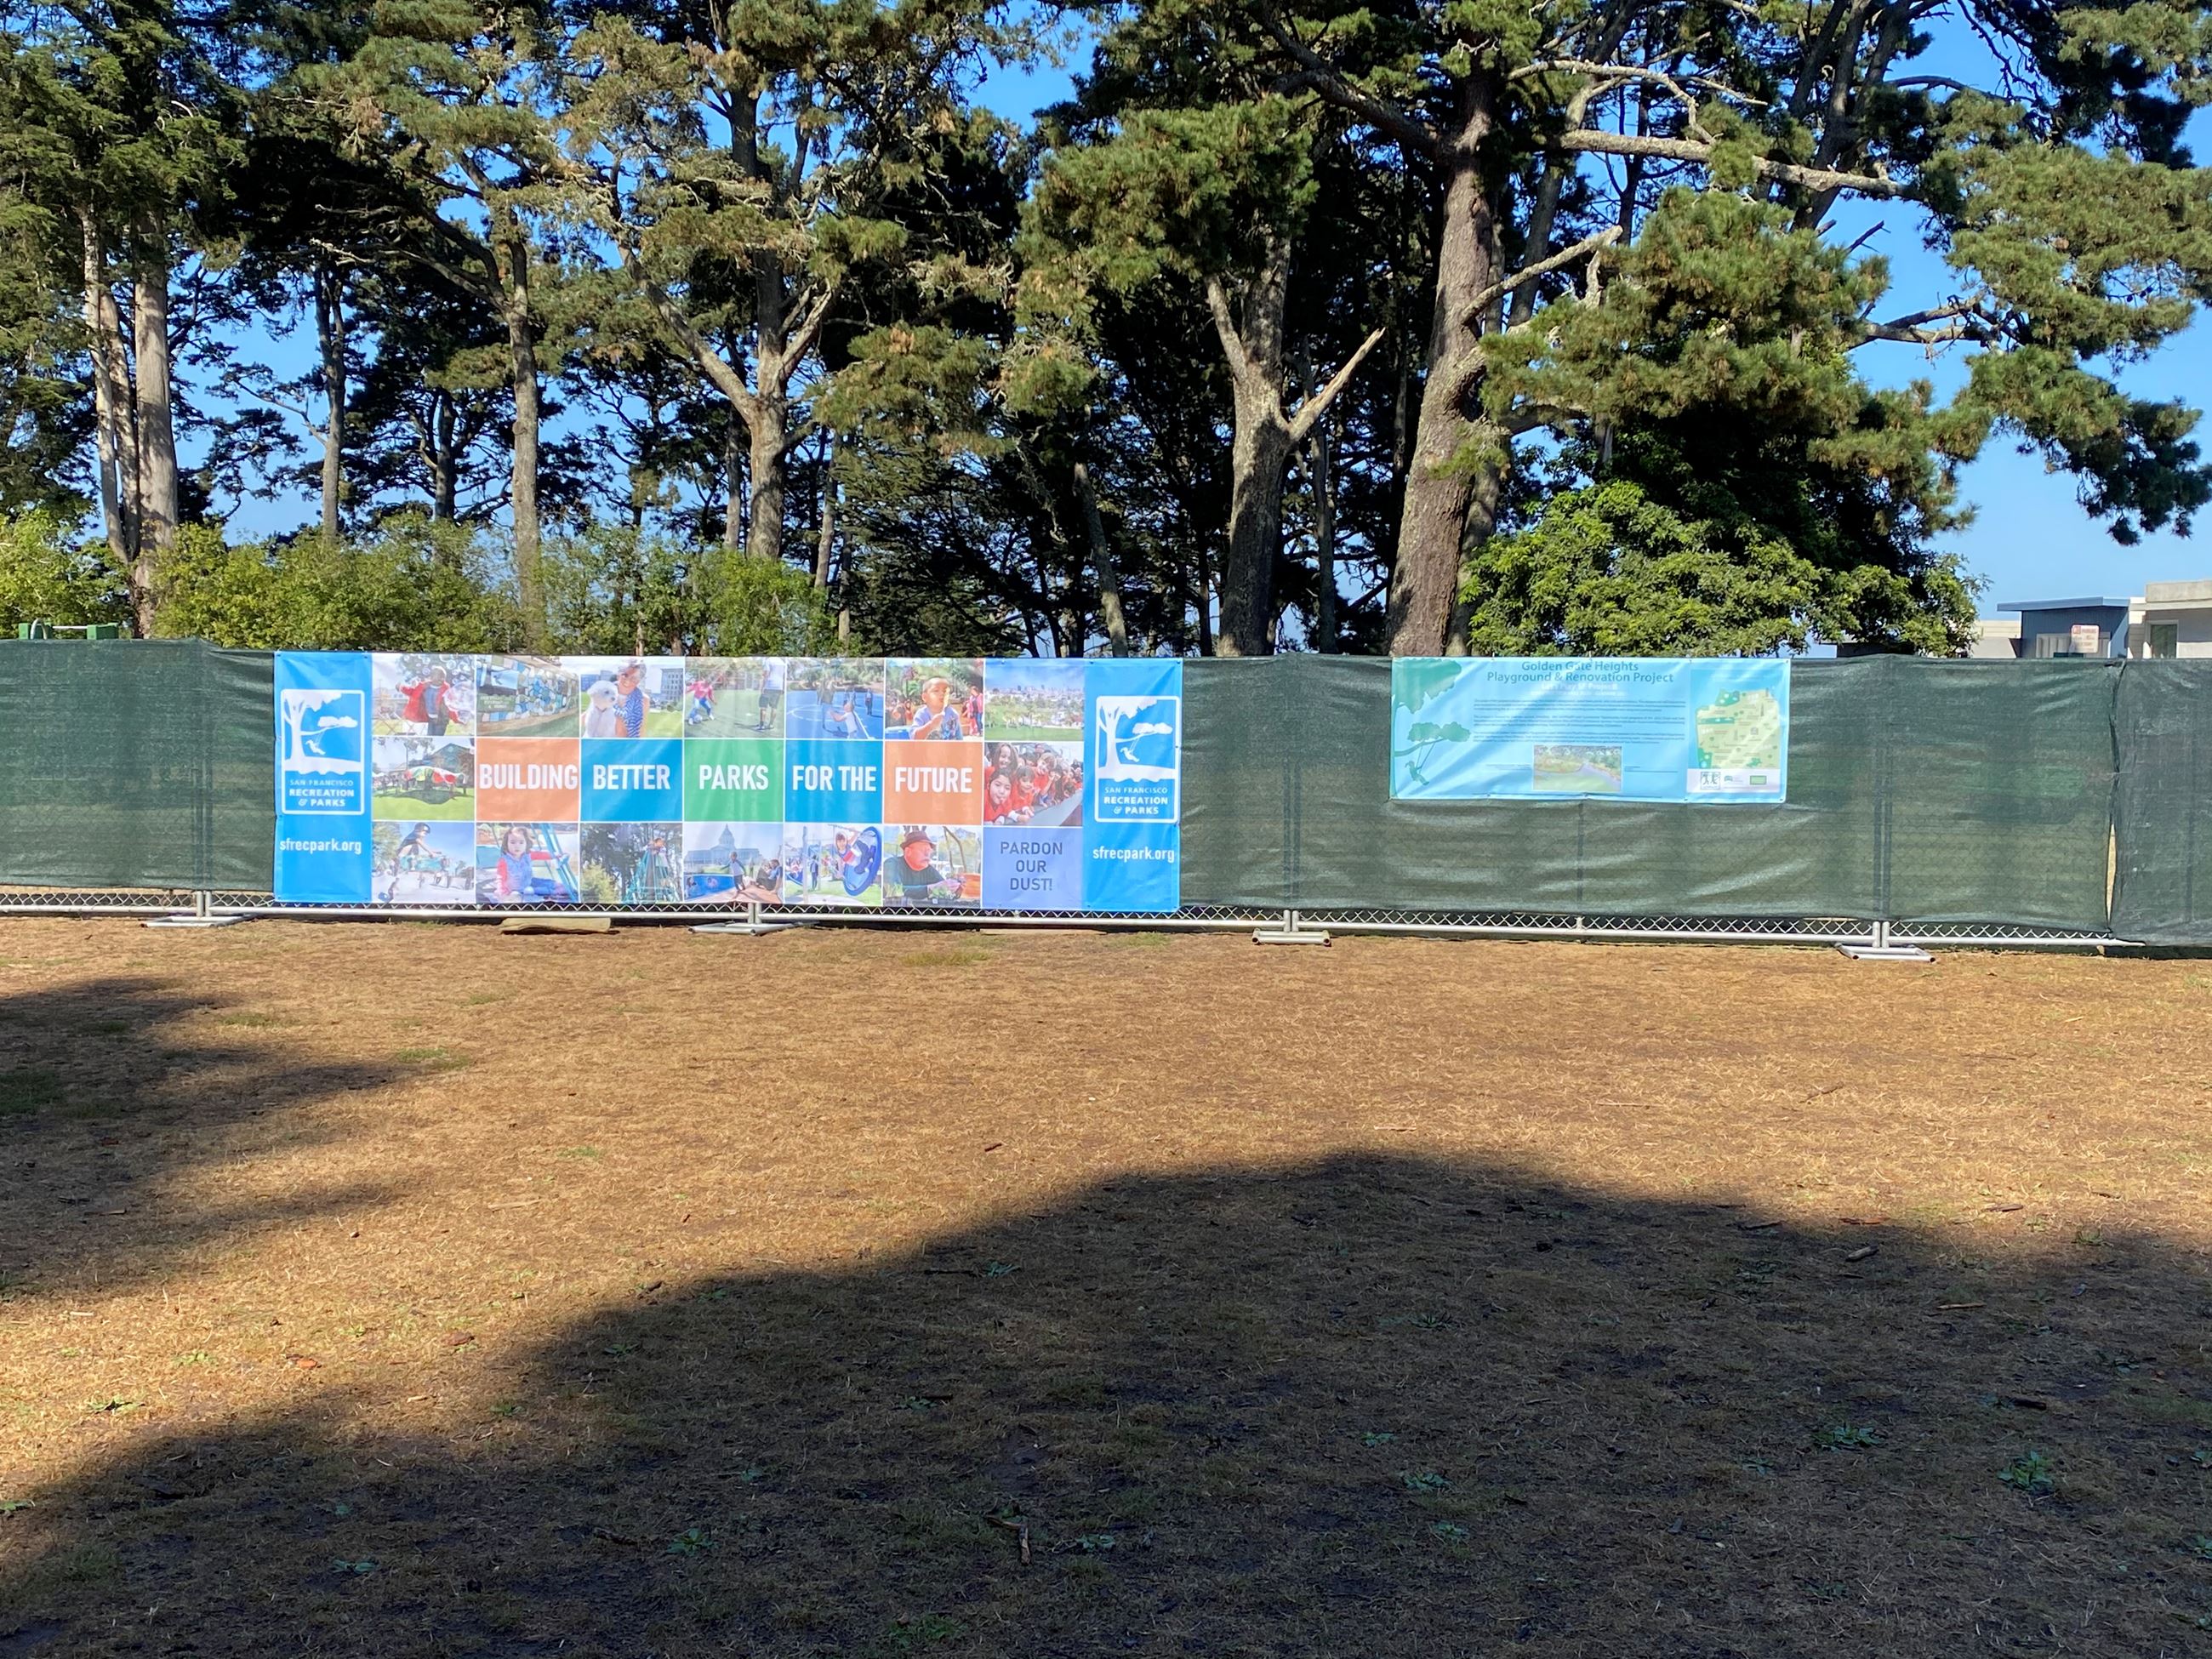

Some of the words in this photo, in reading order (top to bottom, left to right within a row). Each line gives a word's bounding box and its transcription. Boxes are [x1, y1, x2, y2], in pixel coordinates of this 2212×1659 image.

[1521, 661, 1562, 670] Golden
[1565, 661, 1592, 670] Gate
[1595, 661, 1639, 671] Heights
[1487, 671, 1552, 684] Playground
[1555, 671, 1564, 681] &
[1565, 671, 1630, 682] Renovation
[1633, 672, 1673, 684] Project
[479, 764, 578, 790] BUILDING
[593, 765, 670, 790] BETTER
[698, 764, 769, 790] PARKS
[792, 765, 834, 791] FOR
[838, 767, 877, 792] THE
[895, 767, 972, 793] FUTURE
[289, 789, 355, 797] RECREATION
[1103, 796, 1168, 805] RECREATION
[1113, 806, 1122, 814] &
[279, 837, 362, 855] sfrecpark.org
[1001, 841, 1063, 855] PARDON
[1092, 846, 1175, 864] sfrecpark.org
[1016, 859, 1047, 873] OUR
[1010, 878, 1052, 891] DUST!
